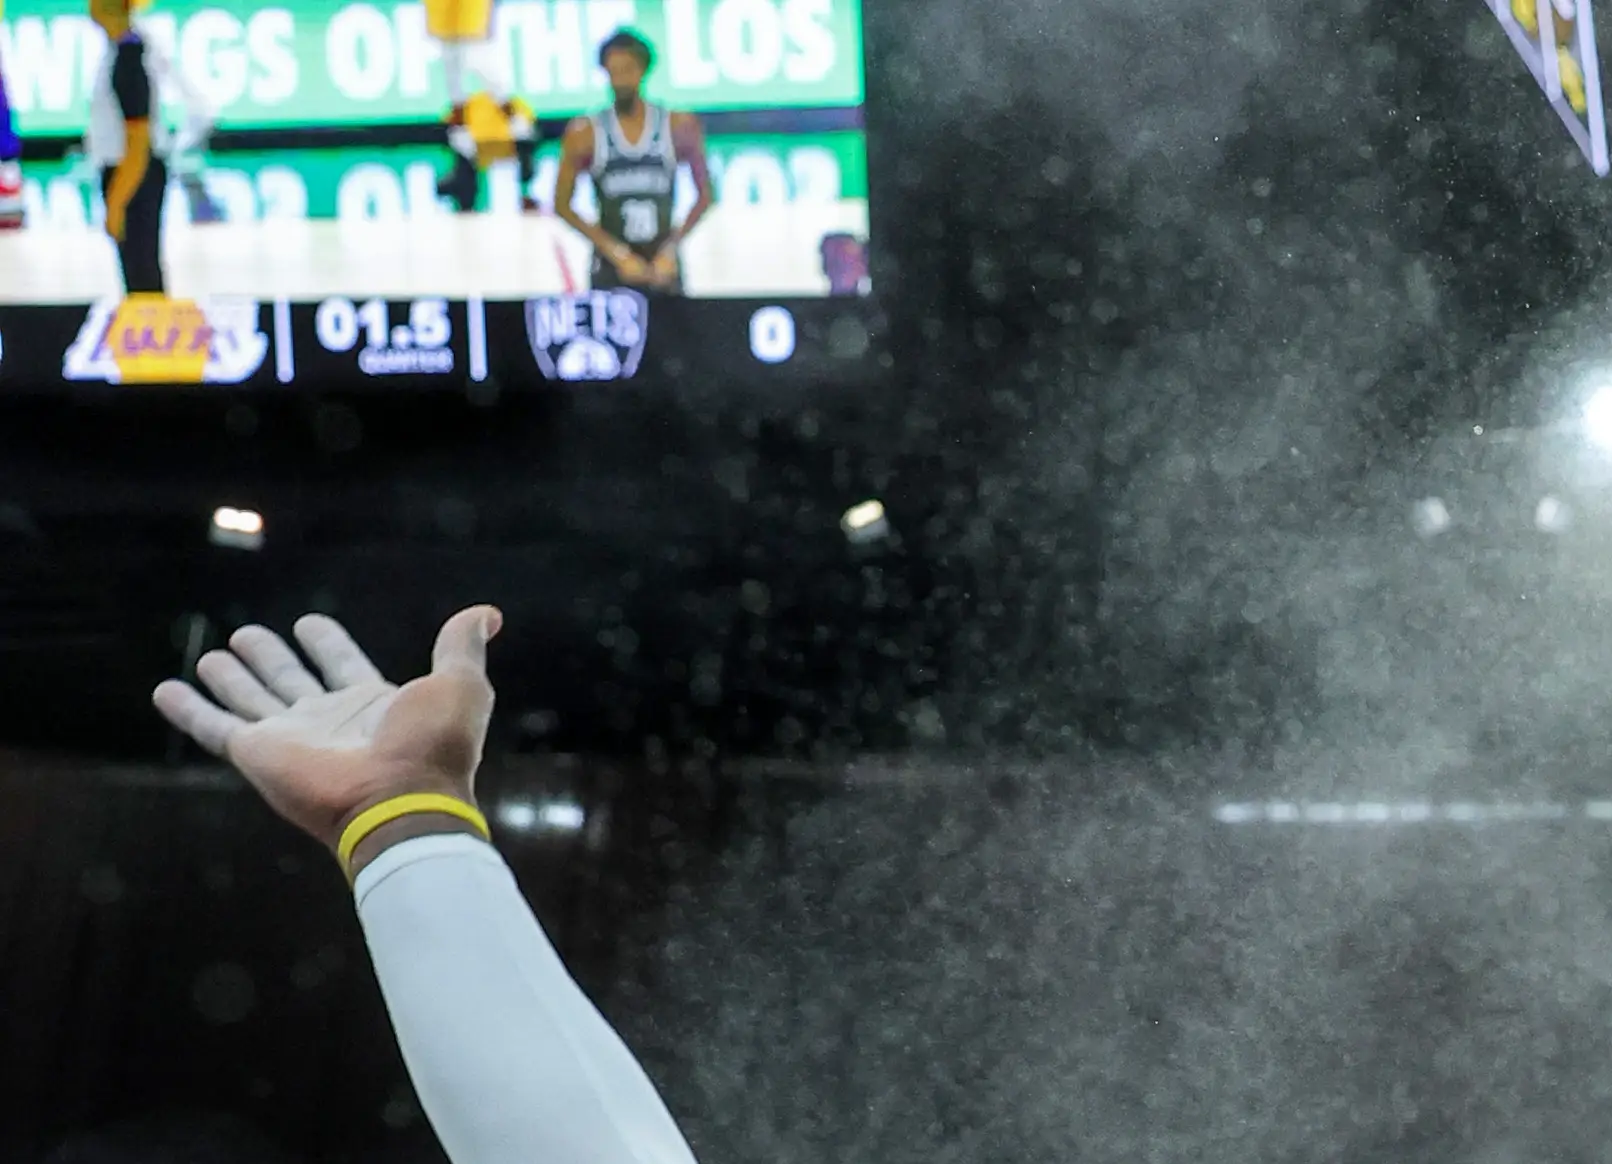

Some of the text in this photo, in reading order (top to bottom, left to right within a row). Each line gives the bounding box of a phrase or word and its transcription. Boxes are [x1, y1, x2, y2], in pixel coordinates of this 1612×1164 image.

[5, 8, 299, 110] WGS
[666, 0, 836, 88] LOS
[749, 305, 796, 363] 0
